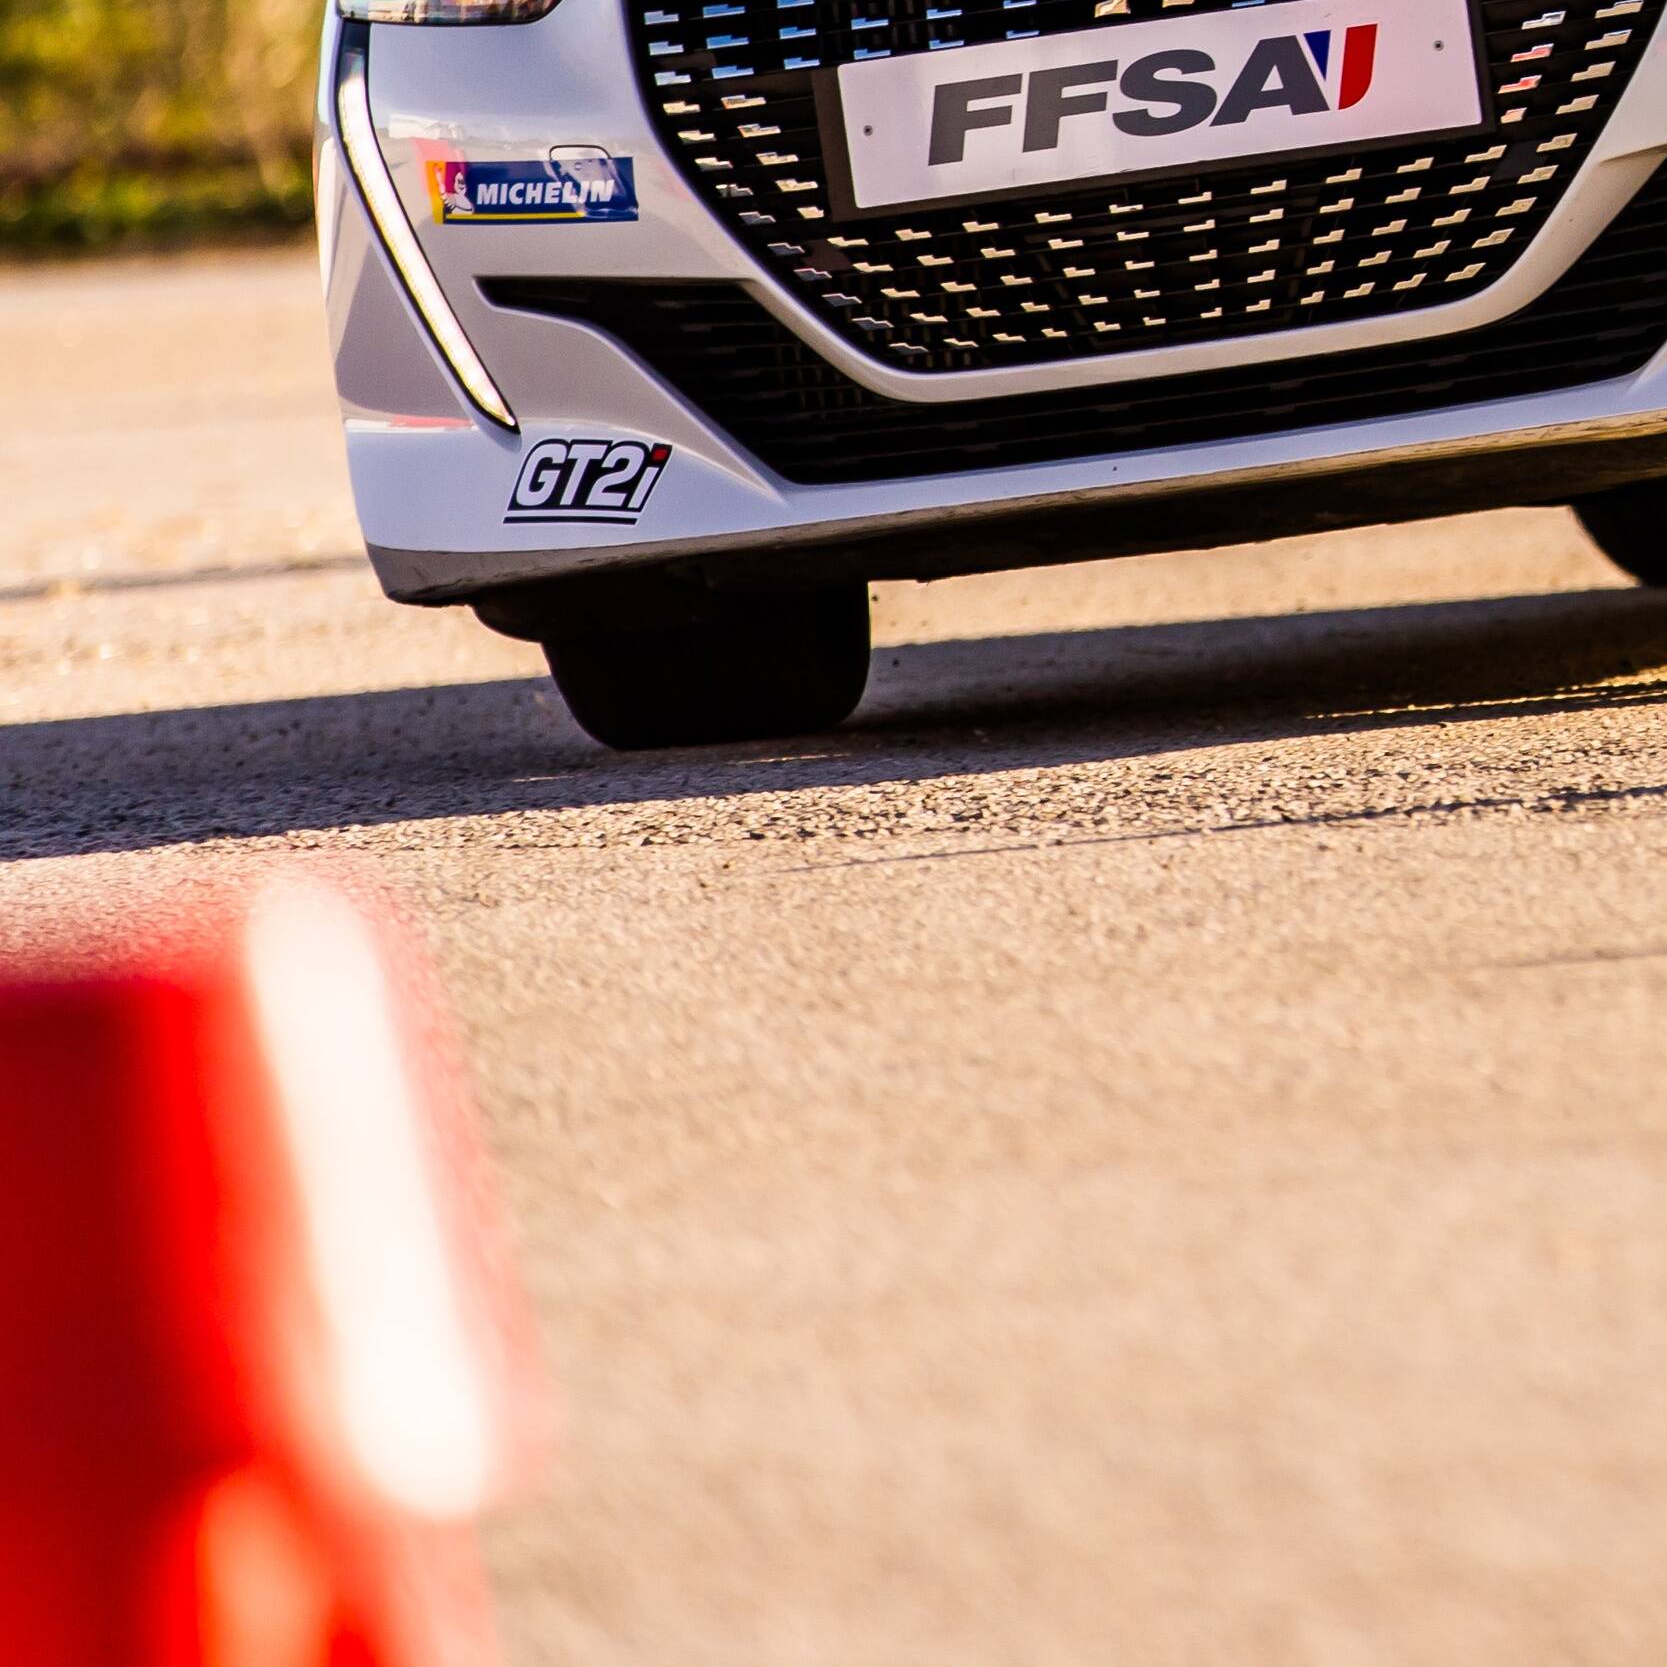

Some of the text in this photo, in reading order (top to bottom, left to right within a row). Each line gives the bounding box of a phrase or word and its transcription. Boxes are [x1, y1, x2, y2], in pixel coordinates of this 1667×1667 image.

[927, 34, 1331, 167] FFSA
[475, 178, 616, 206] MICHELIN
[514, 440, 671, 510] GT2i
